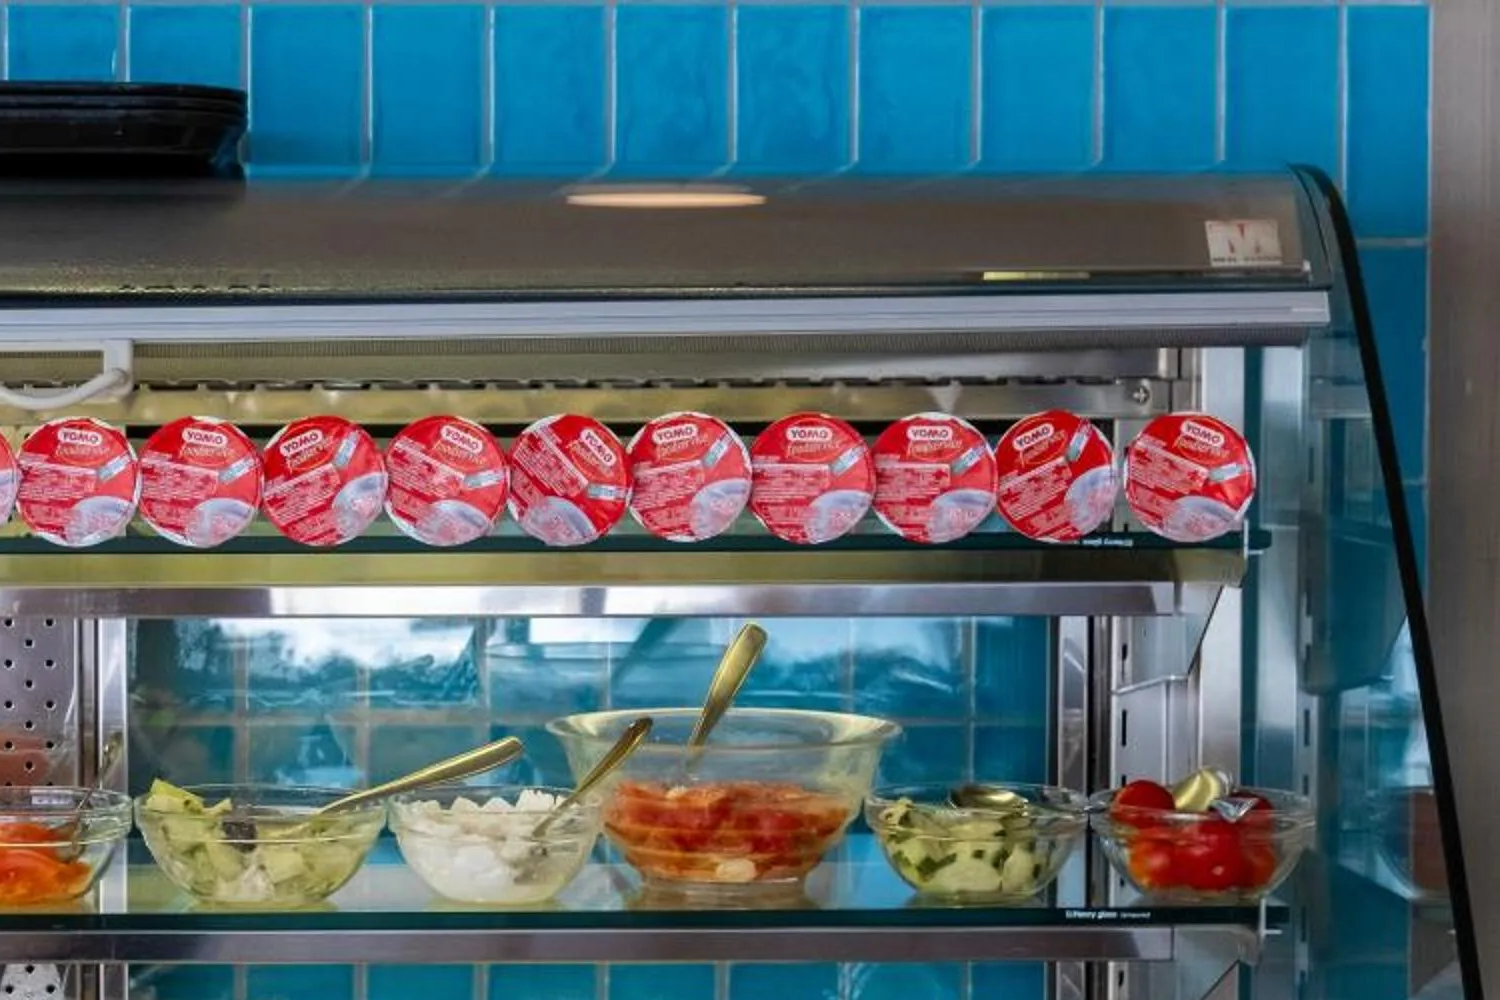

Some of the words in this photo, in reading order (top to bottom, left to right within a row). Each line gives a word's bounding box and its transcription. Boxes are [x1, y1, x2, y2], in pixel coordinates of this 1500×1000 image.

[62, 432, 99, 444] YOMO
[186, 431, 224, 444] YOMO
[445, 428, 479, 451] YOMO
[656, 427, 694, 441] YOMO
[790, 430, 828, 440] YOMO
[911, 428, 950, 439] YOMO
[1015, 426, 1051, 447] YOMO
[1184, 423, 1222, 444] YOMO
[283, 432, 319, 453] YOMO
[584, 431, 613, 463] YOMO
